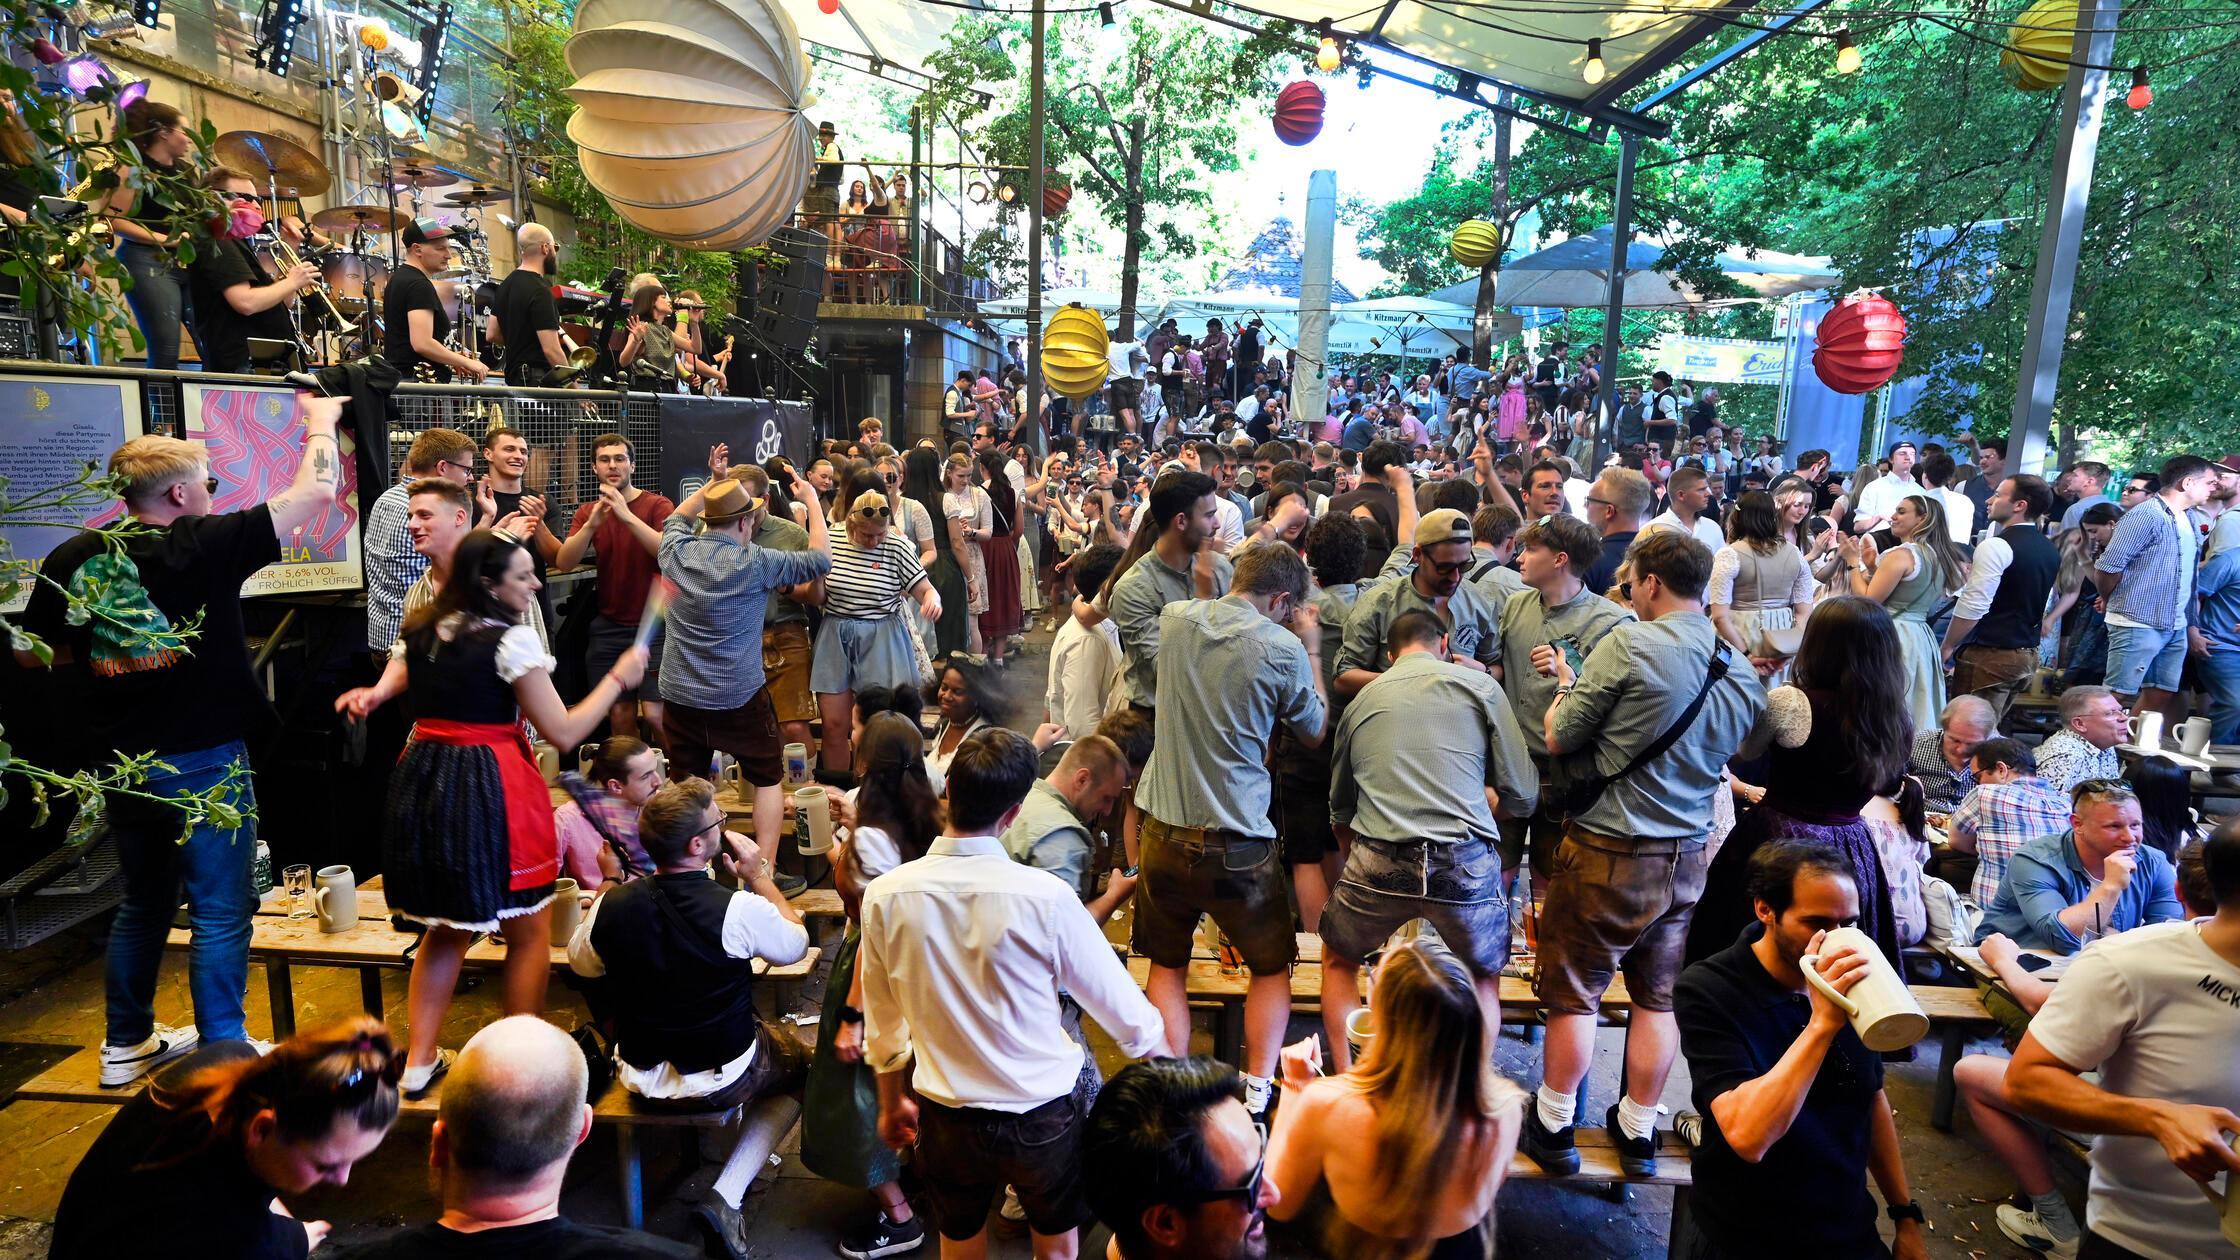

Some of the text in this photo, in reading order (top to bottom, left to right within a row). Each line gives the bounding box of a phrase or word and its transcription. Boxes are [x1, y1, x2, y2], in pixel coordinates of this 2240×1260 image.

[1204, 303, 1234, 312] Kitzmann
[281, 547, 312, 563] ELA
[250, 566, 340, 580] BIER 5,6% VOL.
[258, 577, 313, 590] FRÖHLICH
[322, 575, 358, 586] SÜFFIG
